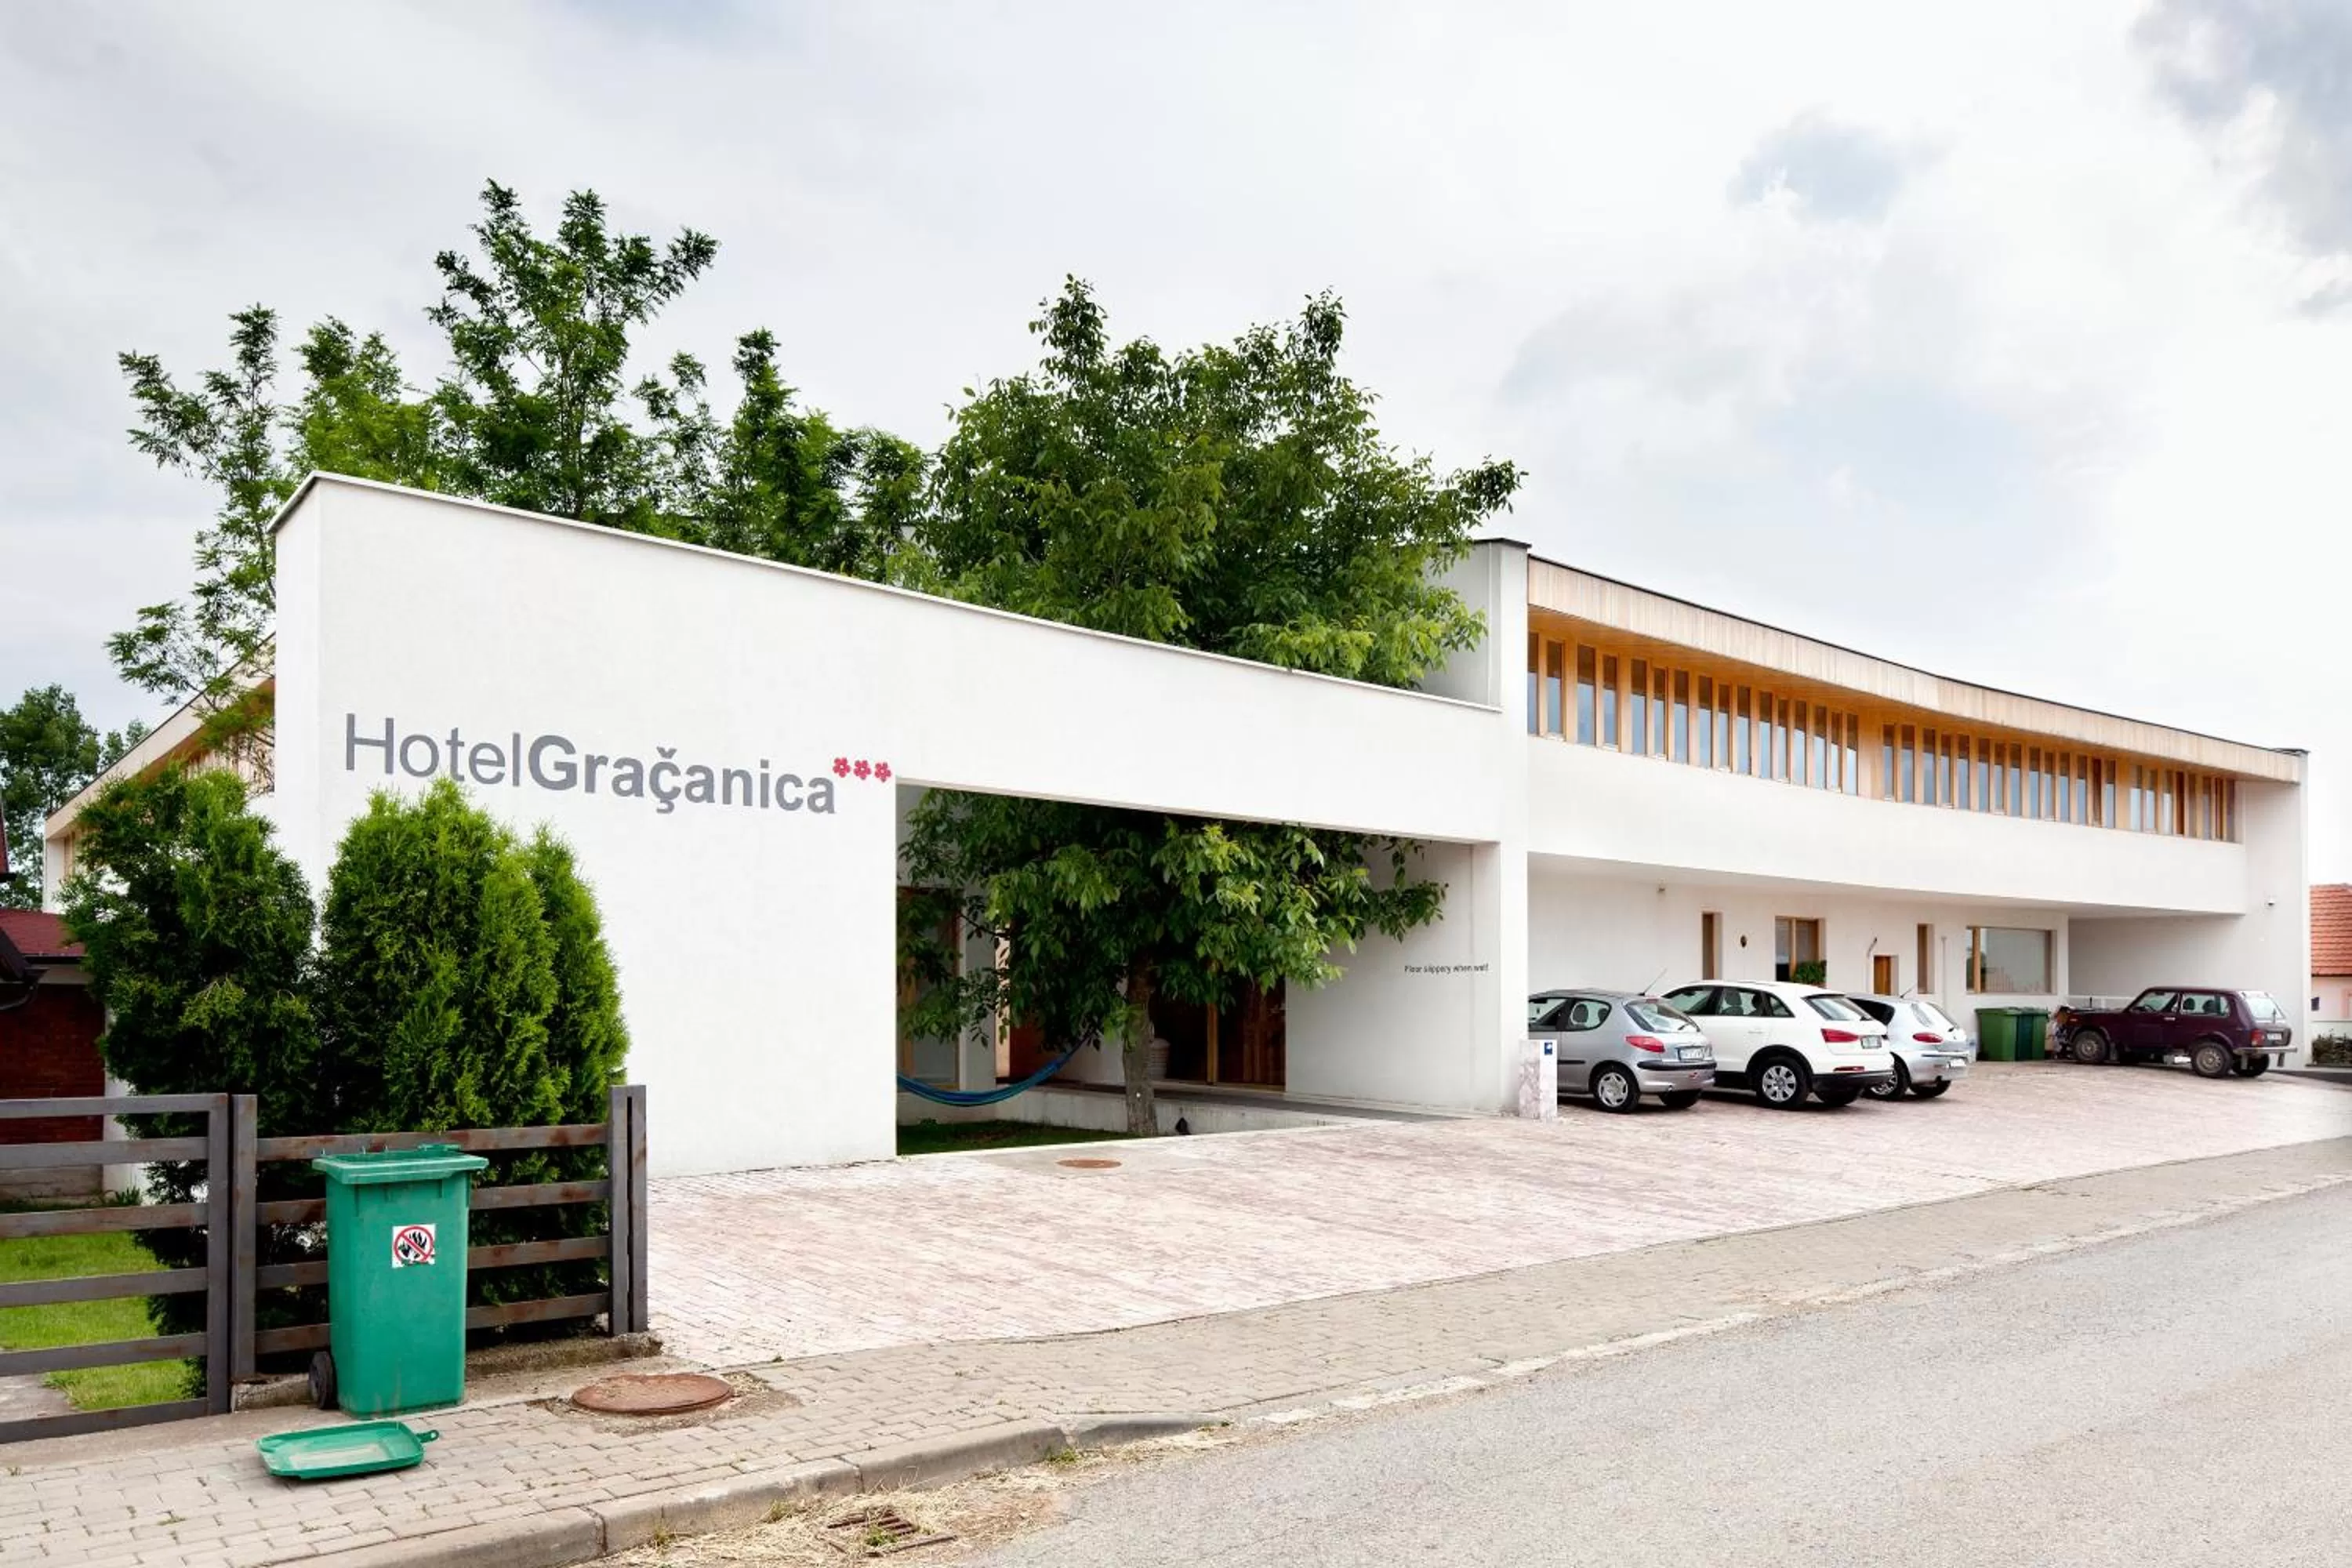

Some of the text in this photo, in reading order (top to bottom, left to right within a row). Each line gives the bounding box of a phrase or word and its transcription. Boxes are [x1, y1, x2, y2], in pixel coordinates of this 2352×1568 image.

[1404, 964, 1423, 973] Floor
[1423, 964, 1450, 975] slippery
[1453, 964, 1473, 972] when
